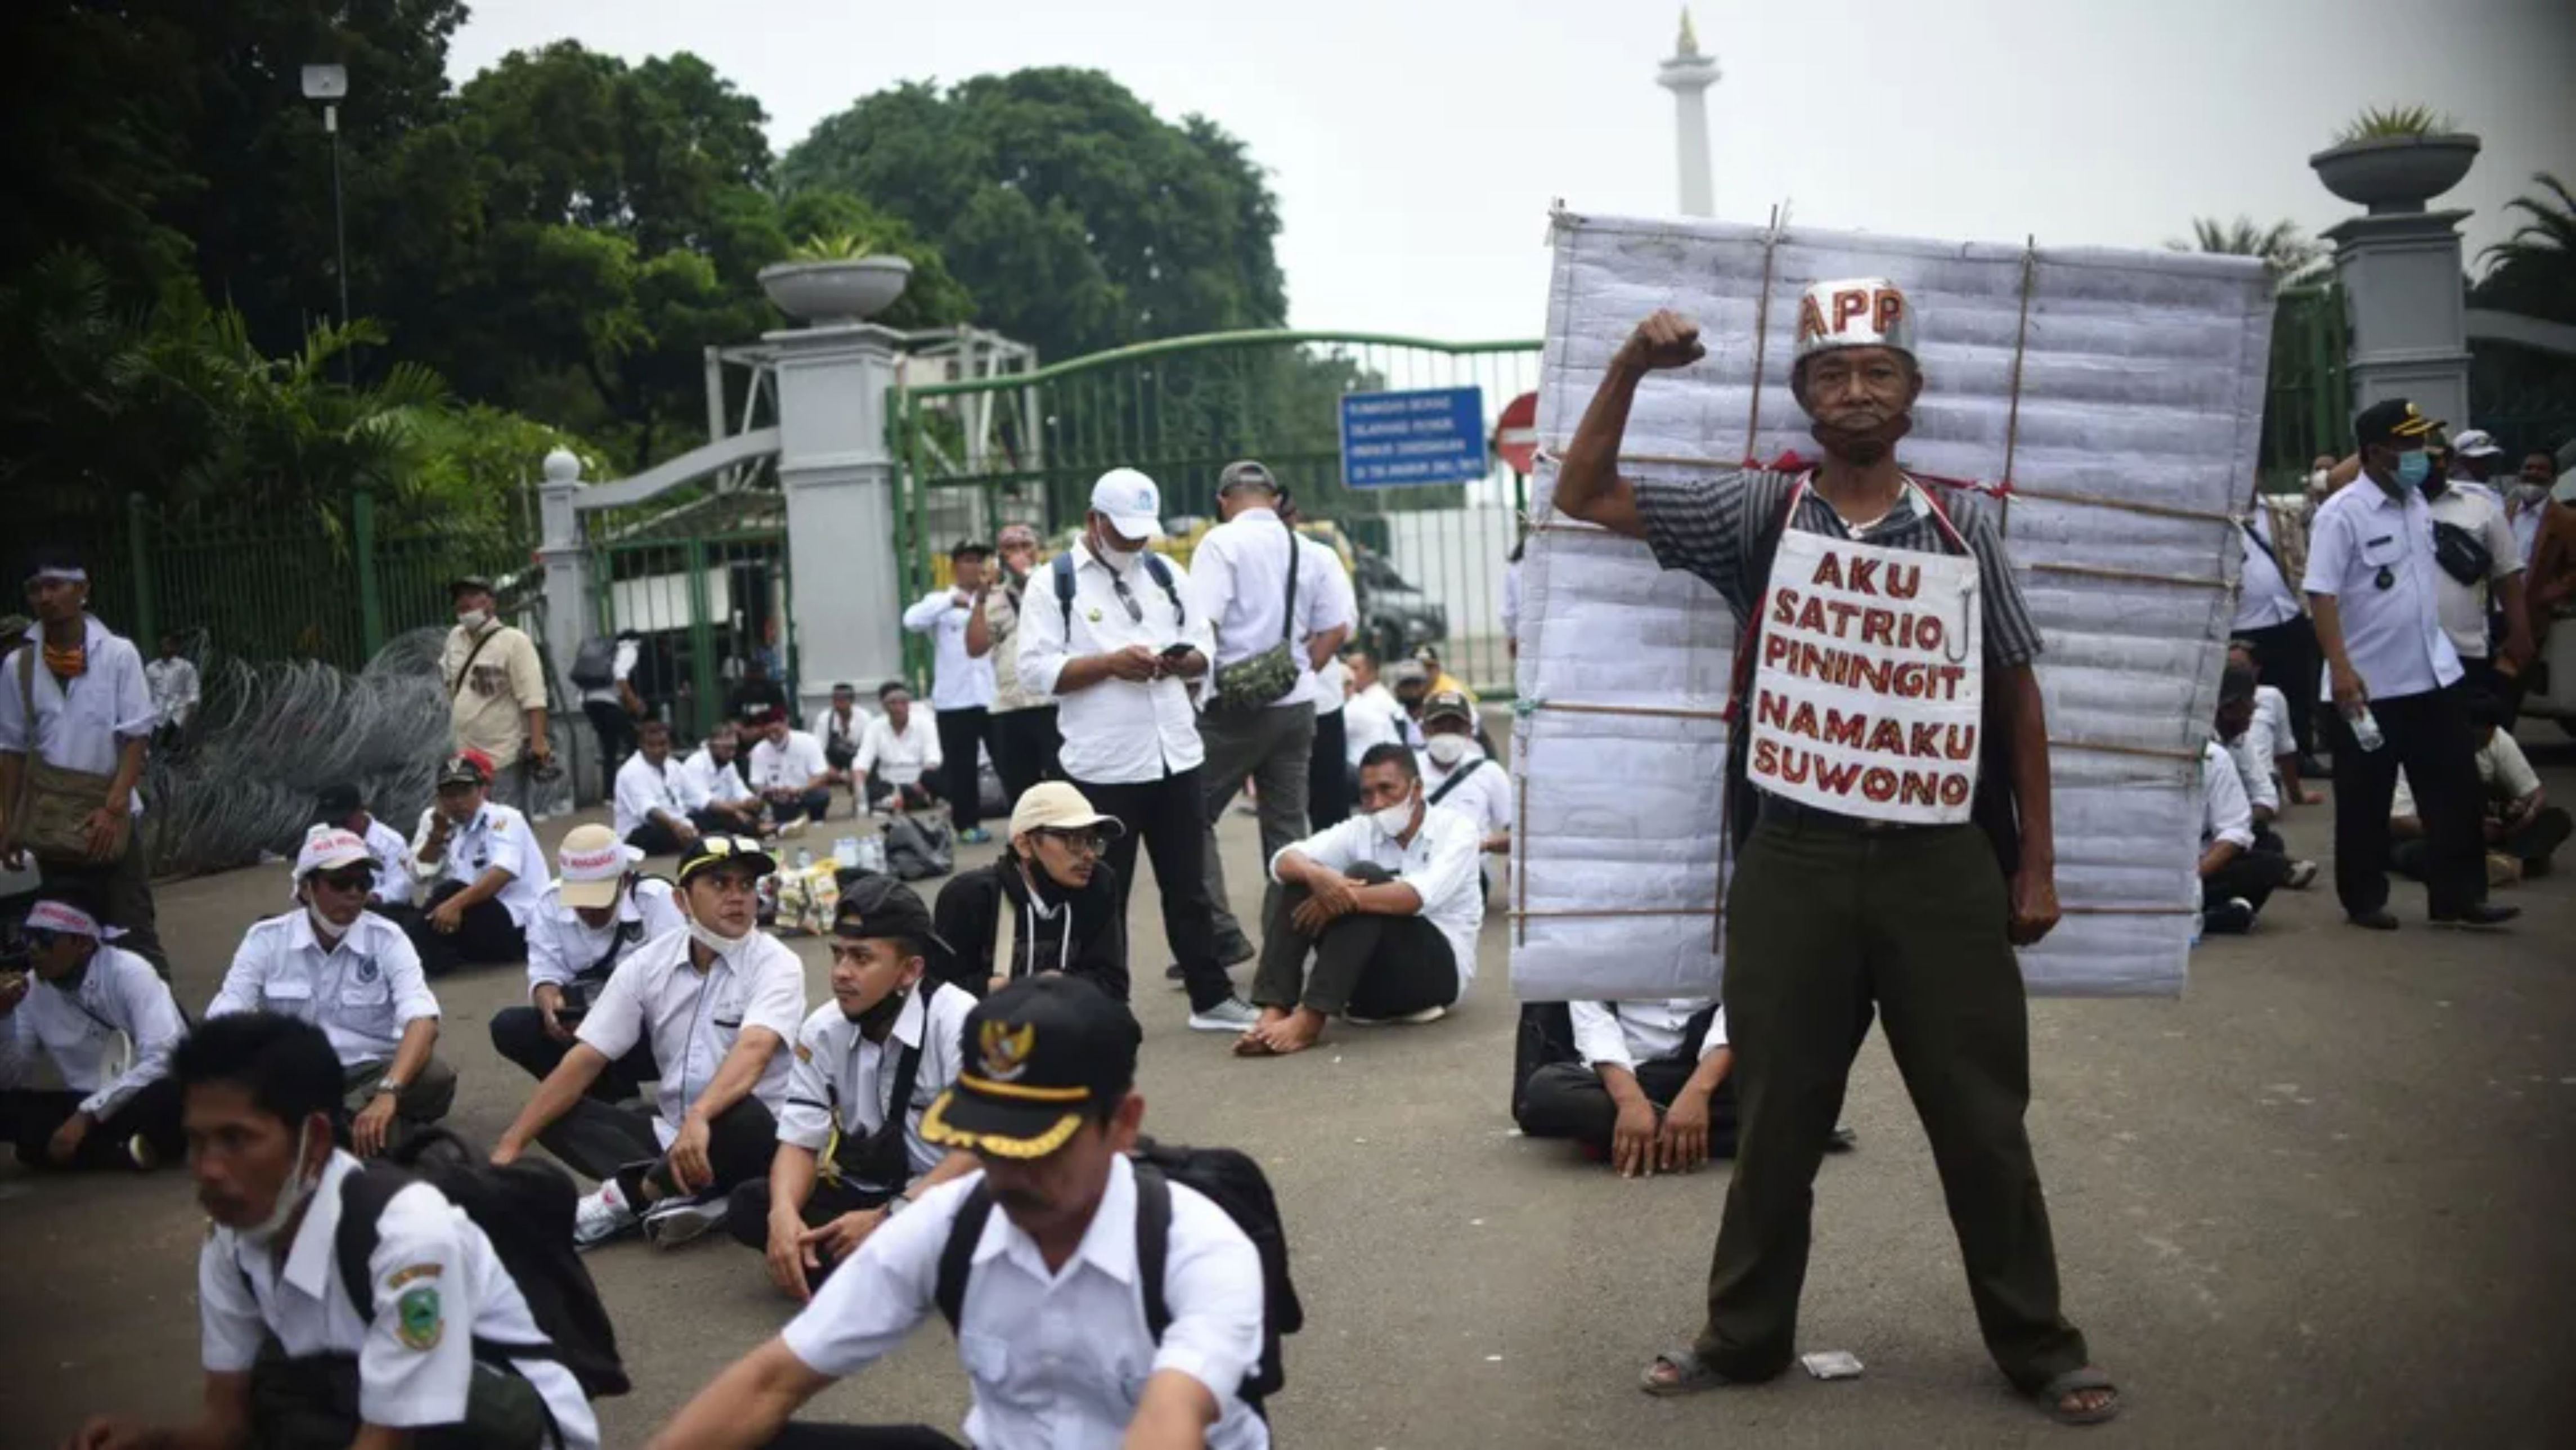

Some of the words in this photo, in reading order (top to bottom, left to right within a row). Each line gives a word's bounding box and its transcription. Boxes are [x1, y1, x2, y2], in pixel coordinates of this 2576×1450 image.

[1797, 289, 1902, 342] APP
[1811, 551, 1921, 600] AKU
[1772, 587, 1944, 651] SATRIO
[1765, 632, 1965, 701] PININGIT
[1757, 689, 1975, 761] NAMAKU
[1753, 737, 1969, 807] SUWONO
